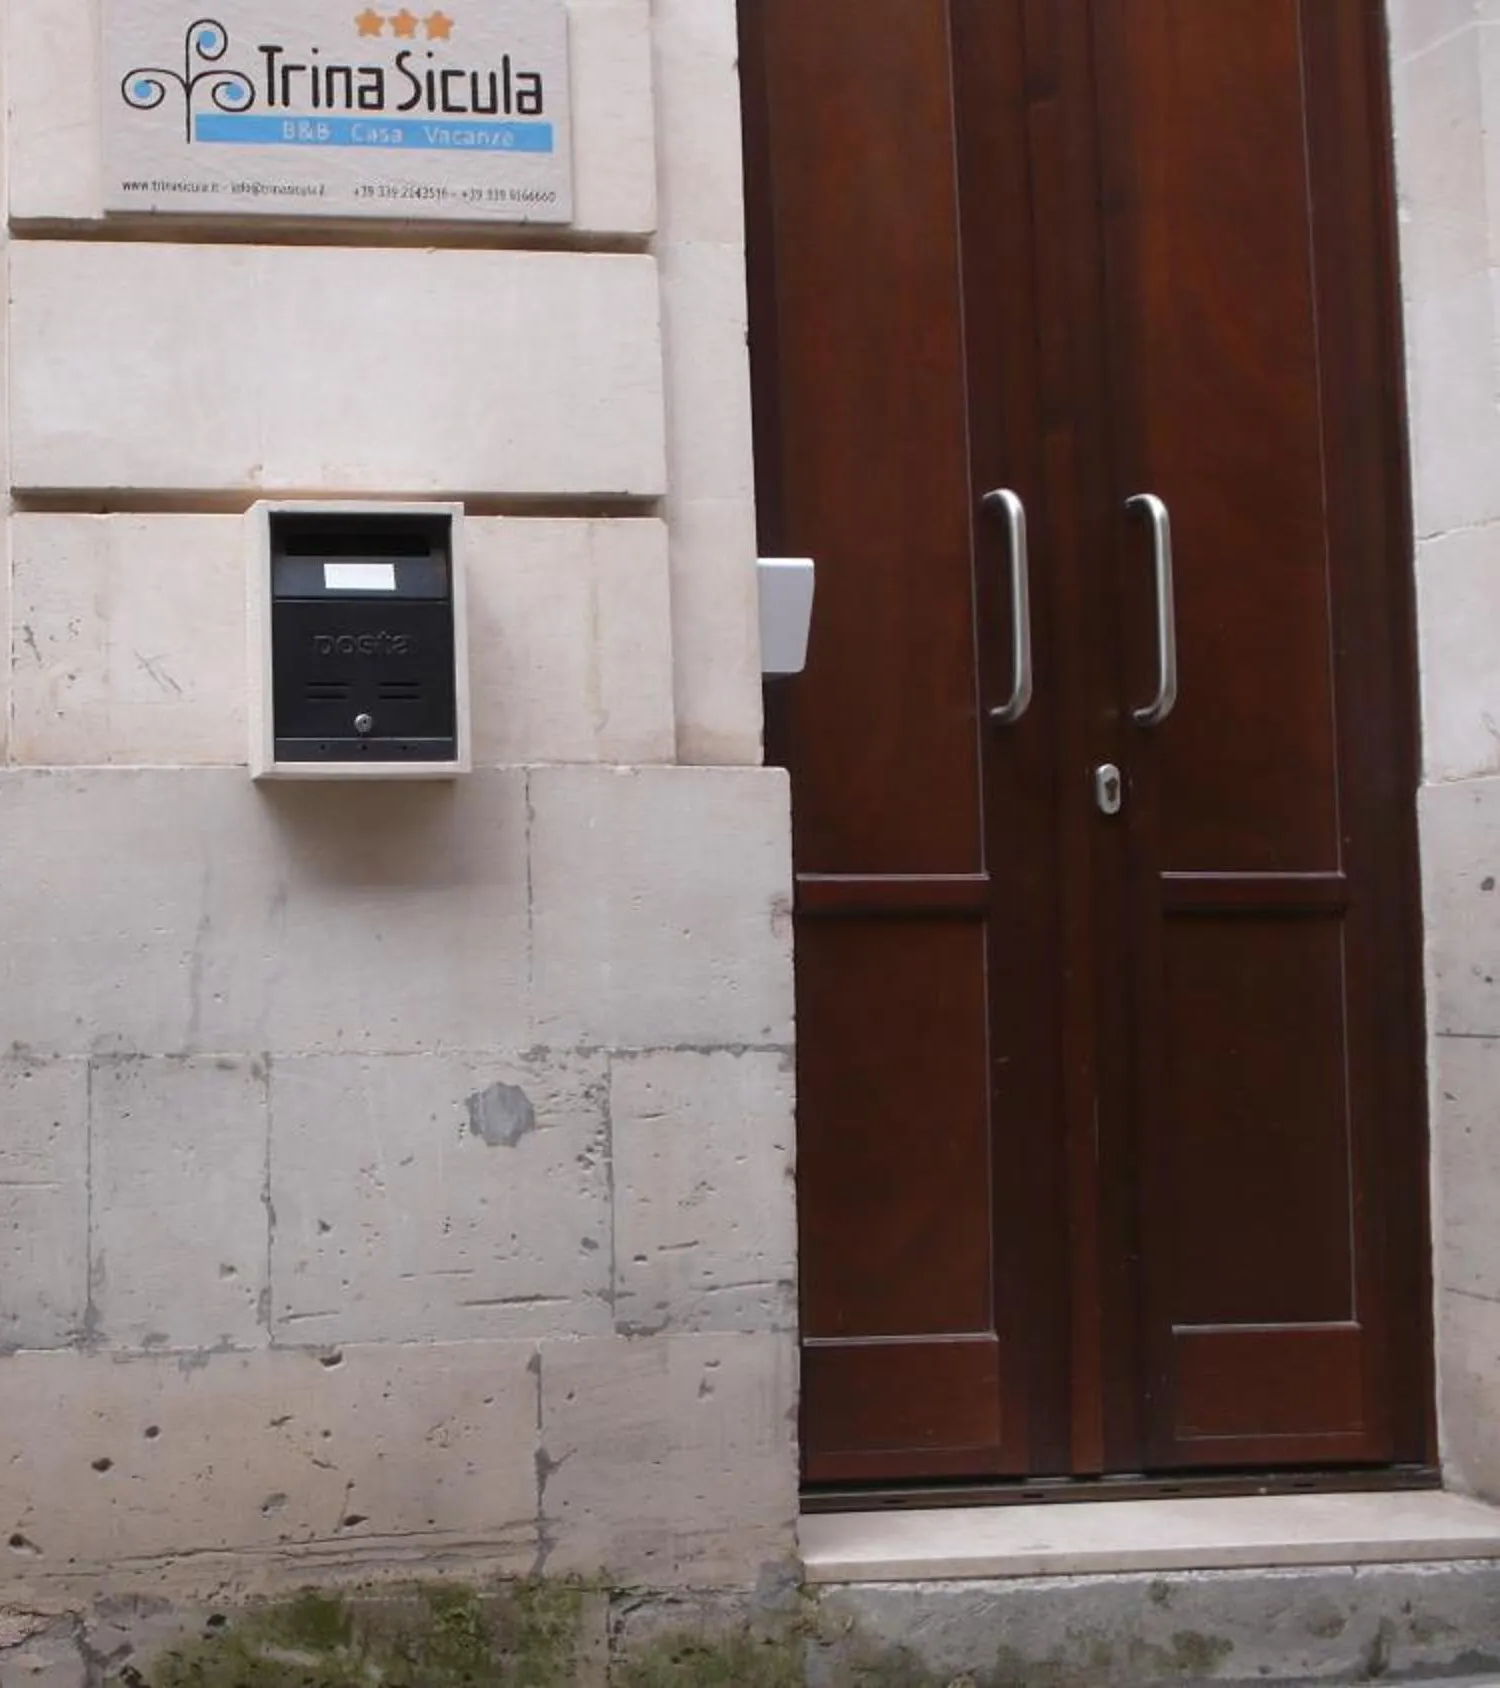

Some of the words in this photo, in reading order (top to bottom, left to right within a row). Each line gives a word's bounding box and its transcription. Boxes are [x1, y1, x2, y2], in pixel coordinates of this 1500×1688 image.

[282, 119, 331, 141] B&B
[350, 122, 404, 144] Casa
[424, 125, 515, 148] Vacanze
